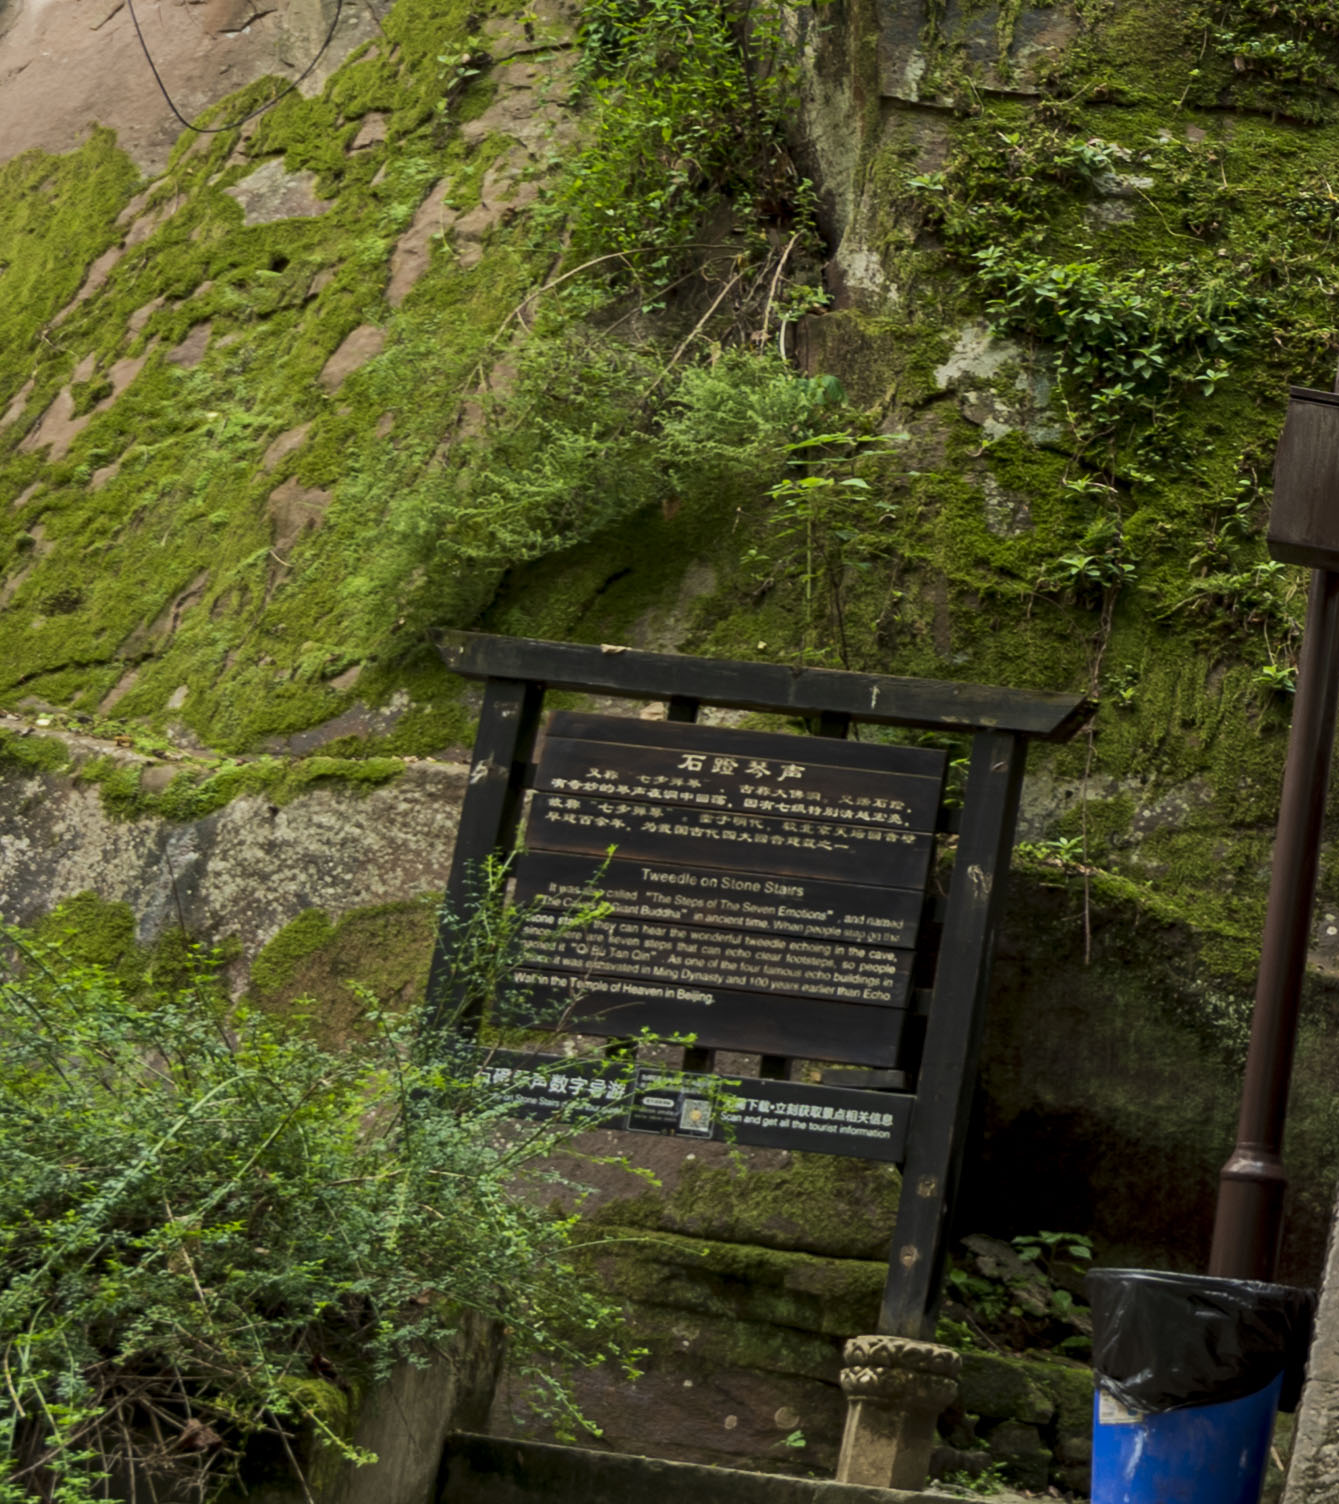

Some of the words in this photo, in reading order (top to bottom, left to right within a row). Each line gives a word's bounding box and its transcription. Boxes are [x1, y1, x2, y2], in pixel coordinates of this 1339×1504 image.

[642, 868, 697, 886] Tweedle
[701, 876, 717, 887] on
[721, 876, 761, 892] Stone
[764, 880, 804, 897] Stairs
[674, 894, 705, 908] Steps
[707, 898, 718, 908] of
[721, 899, 740, 911] The
[742, 902, 775, 915] Seven
[844, 914, 865, 925] and
[867, 916, 904, 929] named
[694, 912, 703, 921] in
[705, 912, 743, 926] ancient
[774, 919, 804, 932] When
[805, 924, 841, 936] people
[619, 921, 639, 932] can
[642, 923, 666, 936] hear
[669, 926, 687, 938] the
[690, 930, 742, 945] wonderful
[745, 936, 786, 950] tweedle
[789, 941, 832, 956] echoing
[834, 945, 845, 955] in
[848, 946, 865, 958] the
[869, 950, 897, 962] cave,
[644, 938, 673, 951] steps
[677, 940, 698, 953] that
[701, 945, 721, 955] can
[725, 947, 752, 959] echo
[755, 950, 782, 962] clear
[842, 959, 855, 969] so
[859, 962, 896, 975] people
[642, 964, 651, 974] in
[653, 966, 678, 980] Ming
[680, 968, 723, 984] Dynasty
[726, 974, 747, 985] and
[750, 977, 768, 987] 100
[770, 979, 800, 990] years
[802, 982, 835, 995] earlier
[837, 986, 861, 998] than
[863, 988, 891, 1001] Echo
[668, 954, 682, 964] As
[684, 956, 705, 967] one
[707, 958, 718, 968] of
[720, 959, 738, 970] the
[740, 962, 761, 973] four
[763, 965, 802, 978] famous
[805, 969, 831, 980] echo
[833, 972, 881, 986] buildings
[883, 977, 893, 987] in
[610, 981, 621, 992] of
[623, 983, 664, 997] Heaven
[665, 987, 675, 997] in
[743, 1115, 761, 1125] and
[763, 1117, 778, 1129] get
[779, 1118, 790, 1128] all
[792, 1119, 807, 1130] the
[809, 1121, 838, 1133] tourist
[839, 1124, 891, 1139] information
